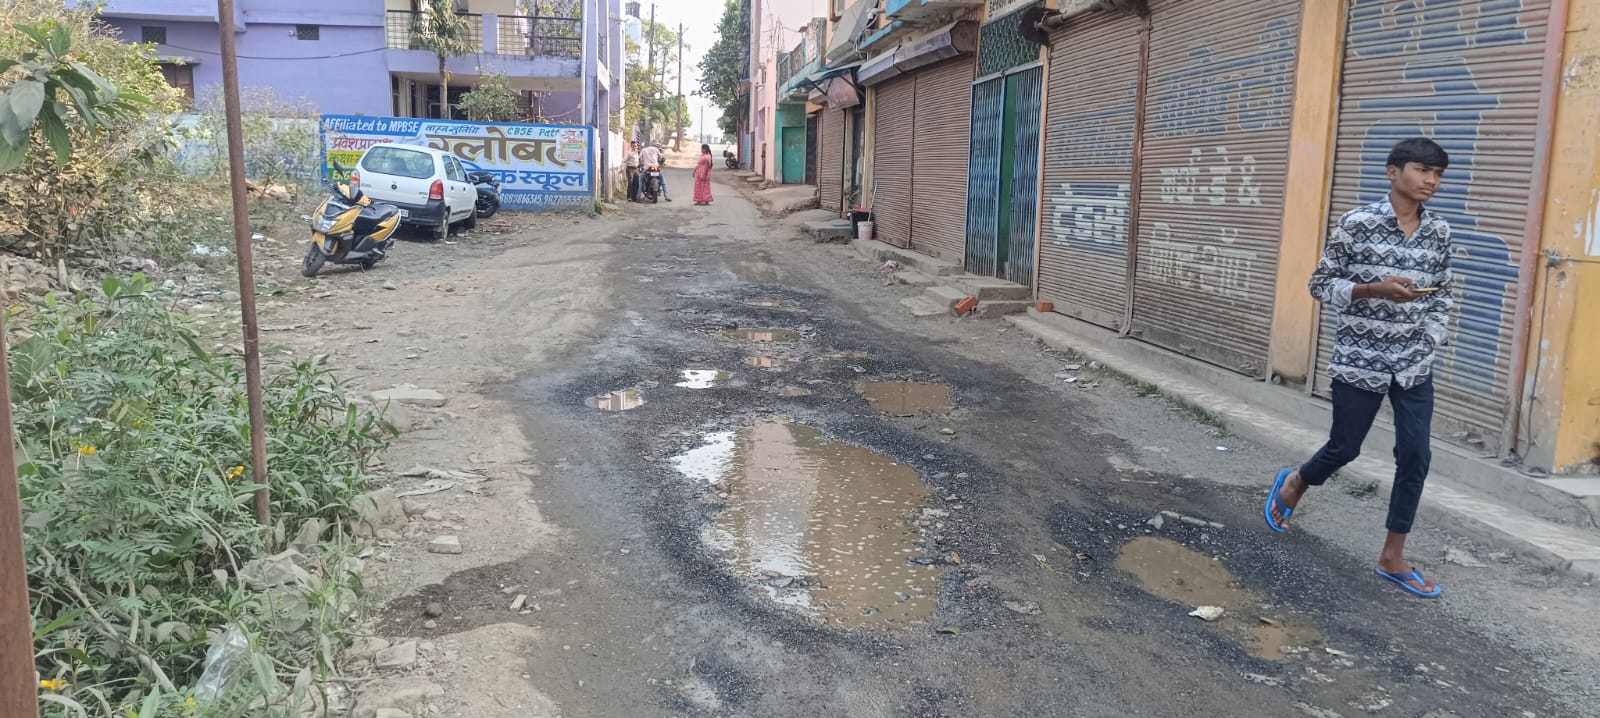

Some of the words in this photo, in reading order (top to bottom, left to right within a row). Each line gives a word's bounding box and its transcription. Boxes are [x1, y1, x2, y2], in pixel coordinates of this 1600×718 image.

[323, 118, 374, 132] Affiliated
[376, 121, 387, 132] to
[388, 121, 419, 134] MPBSE
[507, 127, 533, 136] CBSE
[519, 171, 585, 190] स्कूल
[1238, 155, 1262, 206] &
